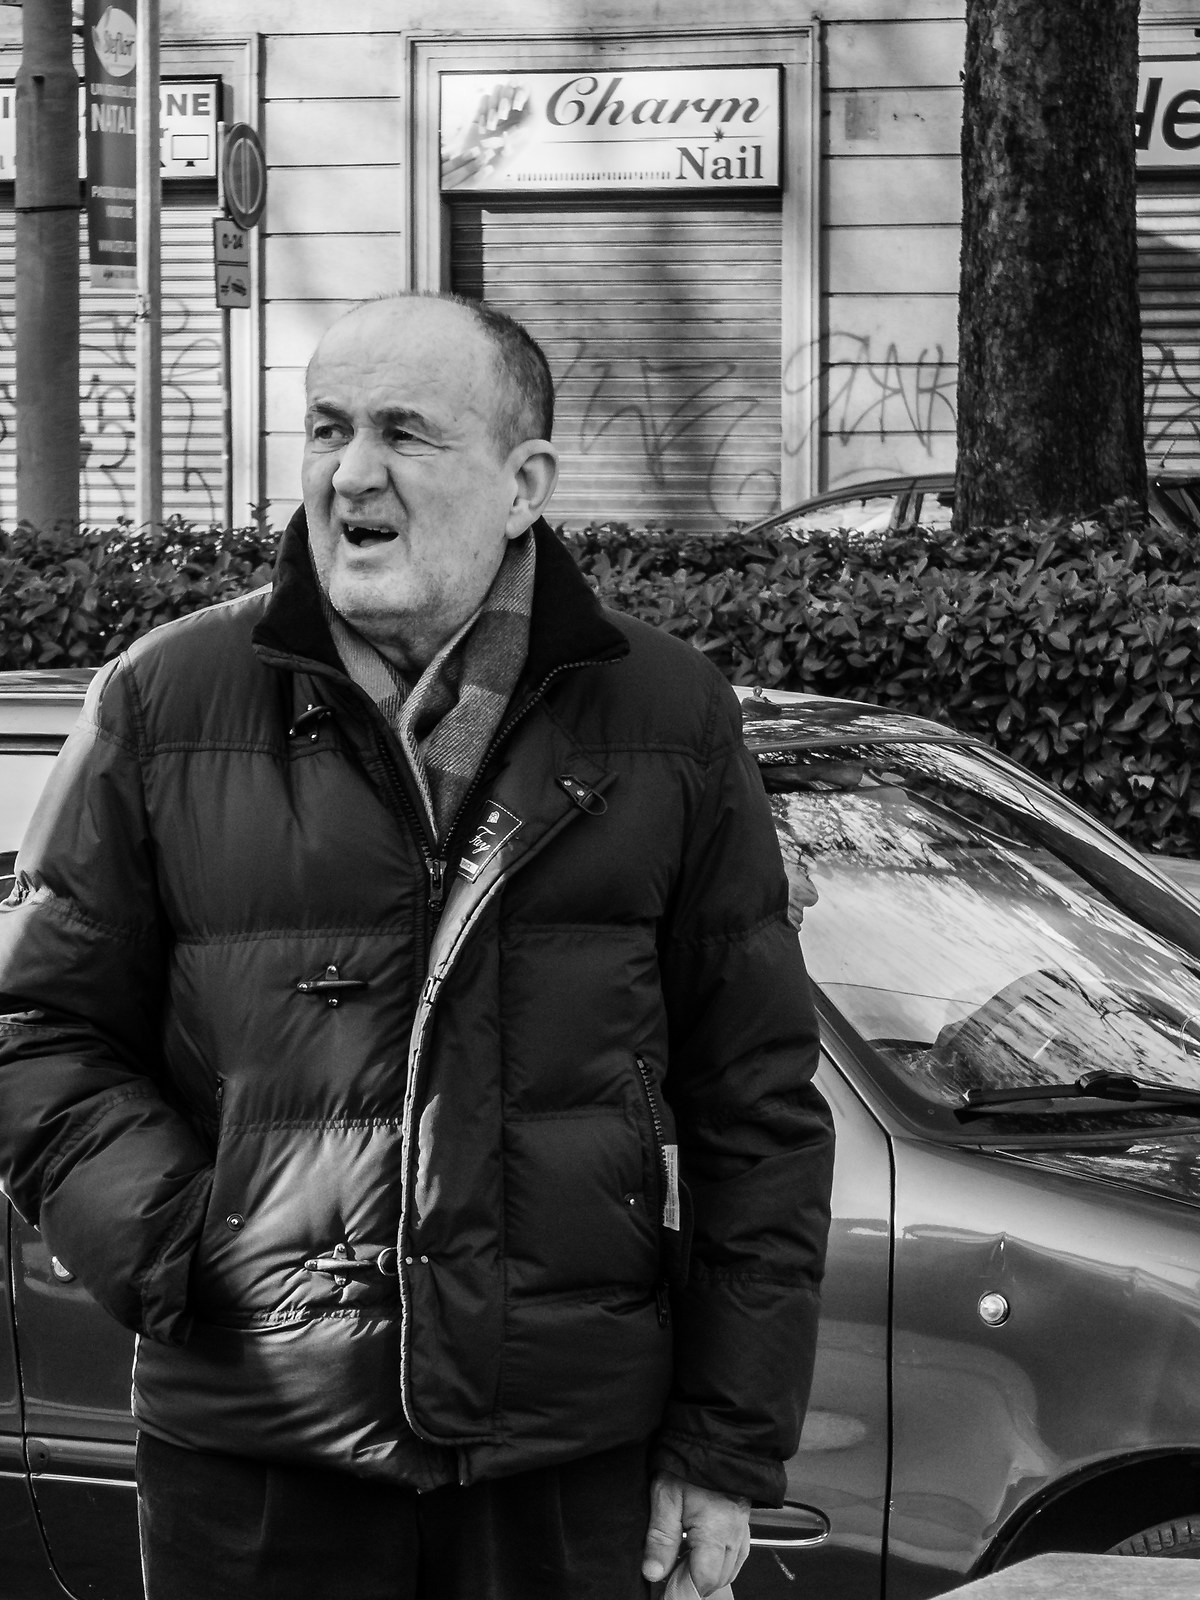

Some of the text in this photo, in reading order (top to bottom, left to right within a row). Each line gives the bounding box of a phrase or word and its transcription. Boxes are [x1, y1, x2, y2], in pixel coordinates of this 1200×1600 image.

[91, 103, 136, 134] NATAL
[546, 77, 770, 127] Charm
[675, 145, 764, 181] Nail
